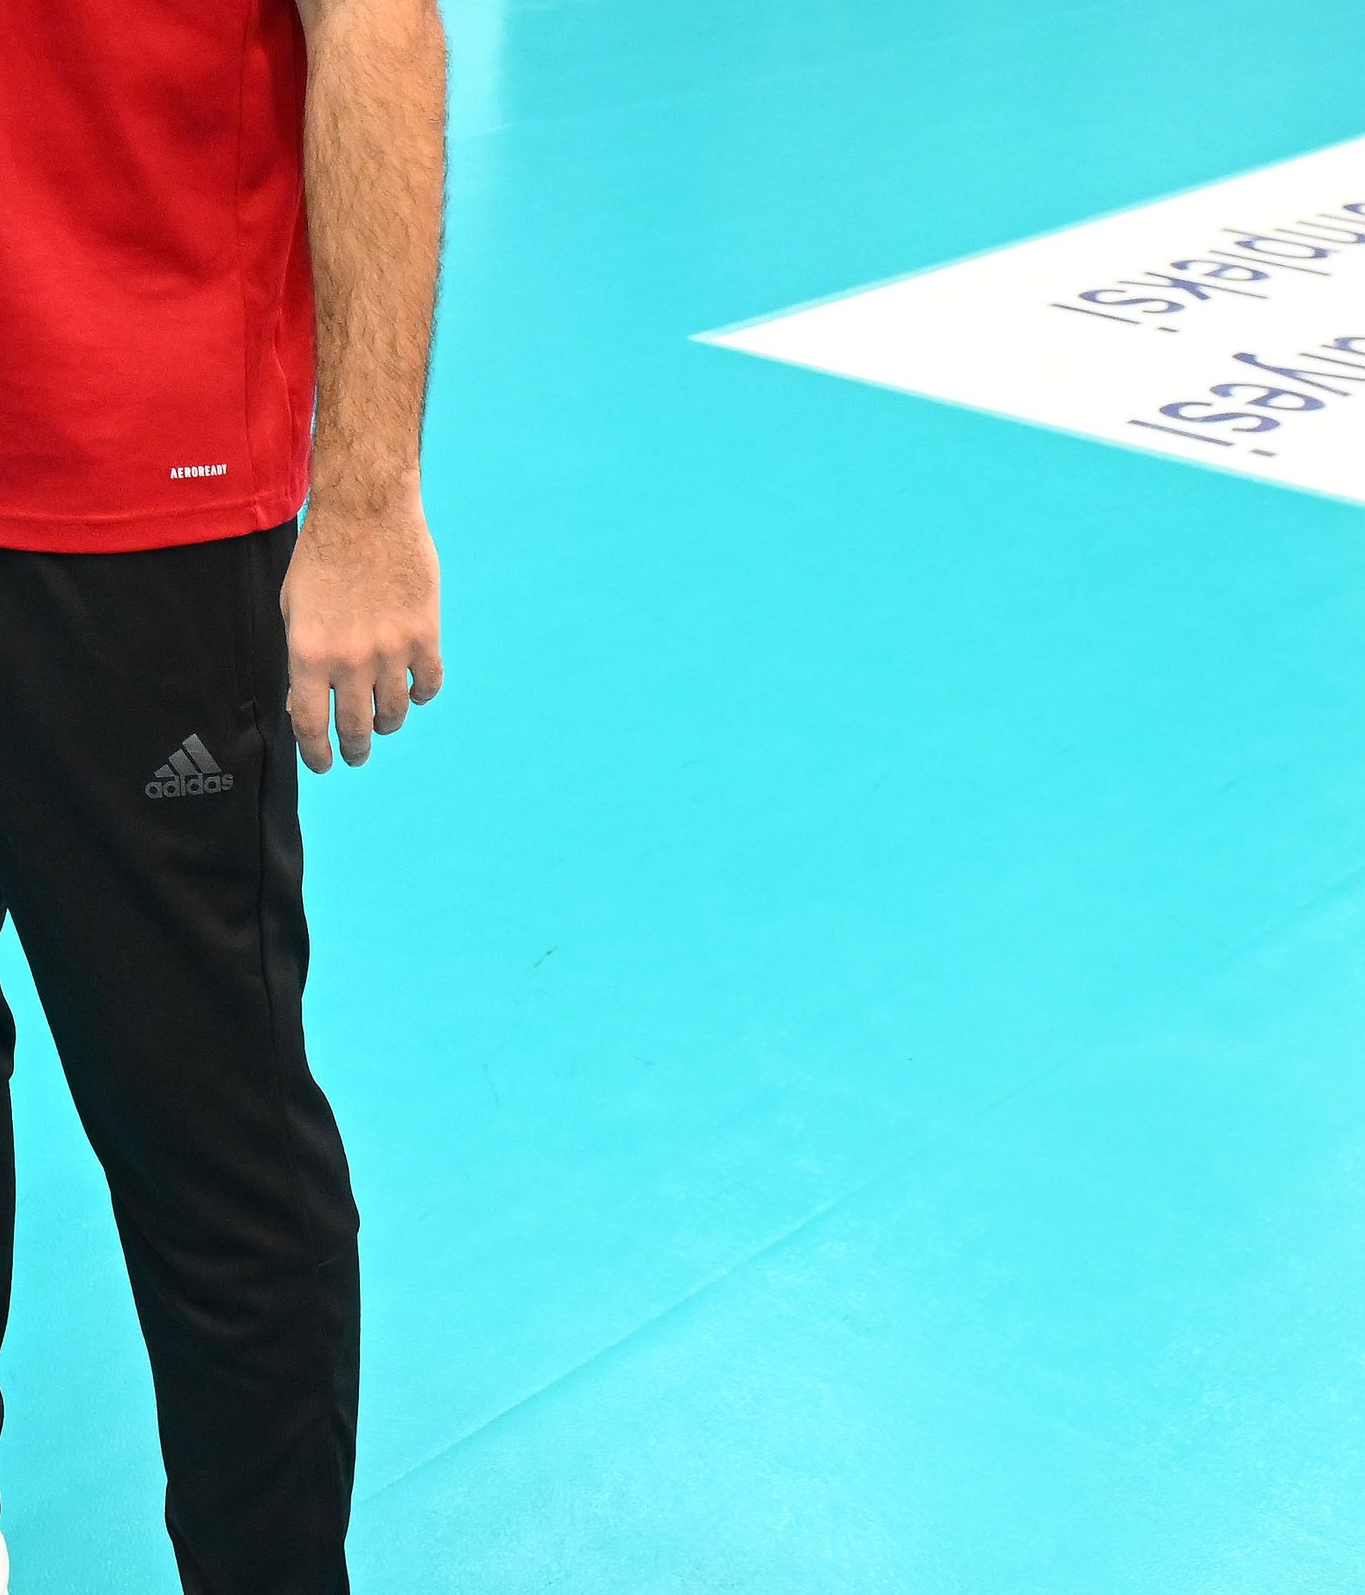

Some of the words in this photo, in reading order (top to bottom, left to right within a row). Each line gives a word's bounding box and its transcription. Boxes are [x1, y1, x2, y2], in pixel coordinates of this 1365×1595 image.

[1049, 202, 1365, 333] mpleksi
[170, 463, 228, 480] AEROREADY
[144, 772, 234, 800] adidas
